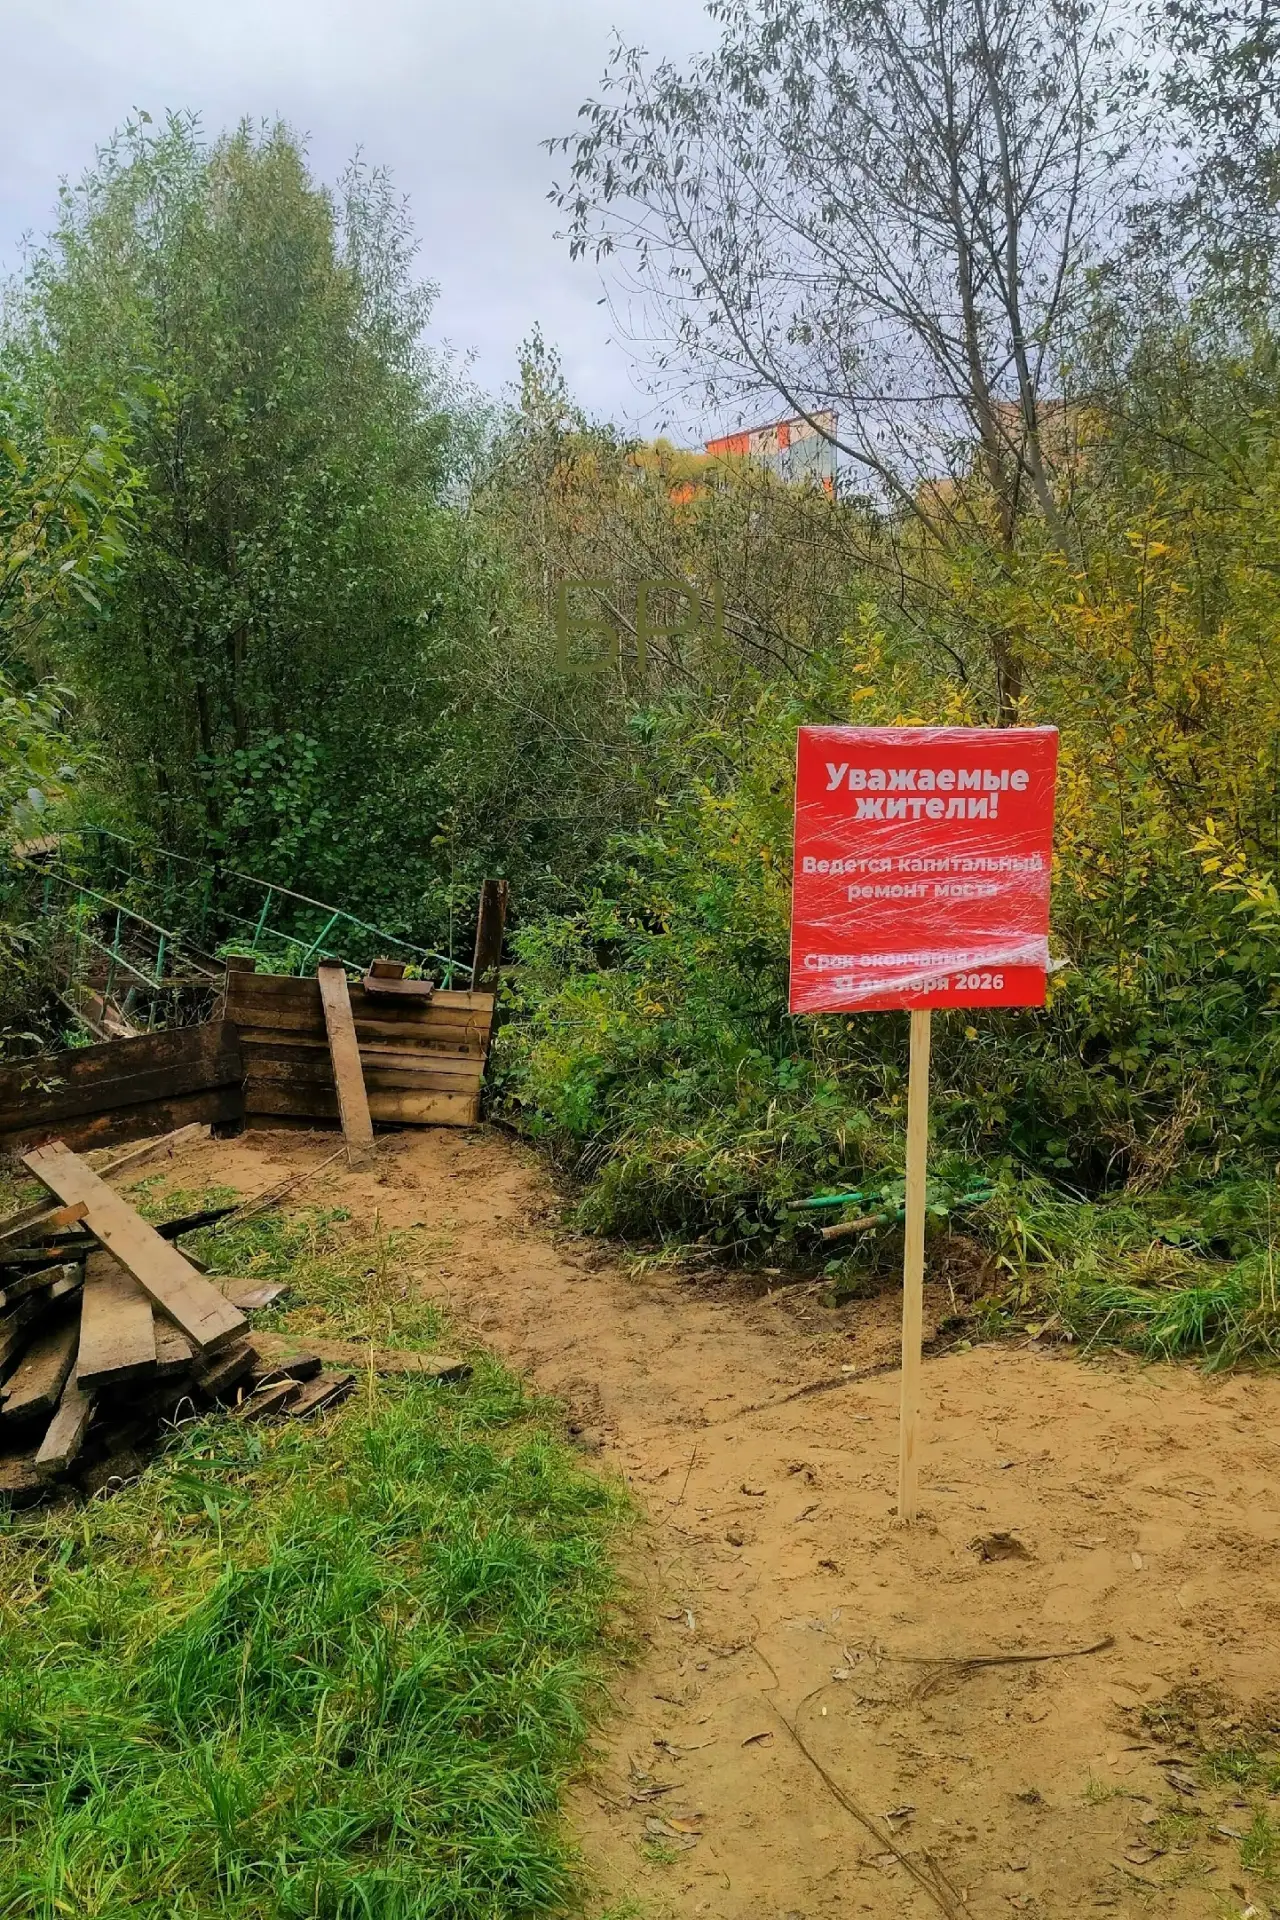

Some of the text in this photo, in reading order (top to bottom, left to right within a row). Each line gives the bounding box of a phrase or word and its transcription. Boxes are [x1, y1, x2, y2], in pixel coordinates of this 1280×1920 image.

[826, 763, 1030, 791] Уважаемые
[855, 792, 998, 820] жители!
[802, 853, 1042, 875] Ведется капитальный
[848, 883, 997, 901] ремонт моста
[954, 973, 1004, 990] 2026
